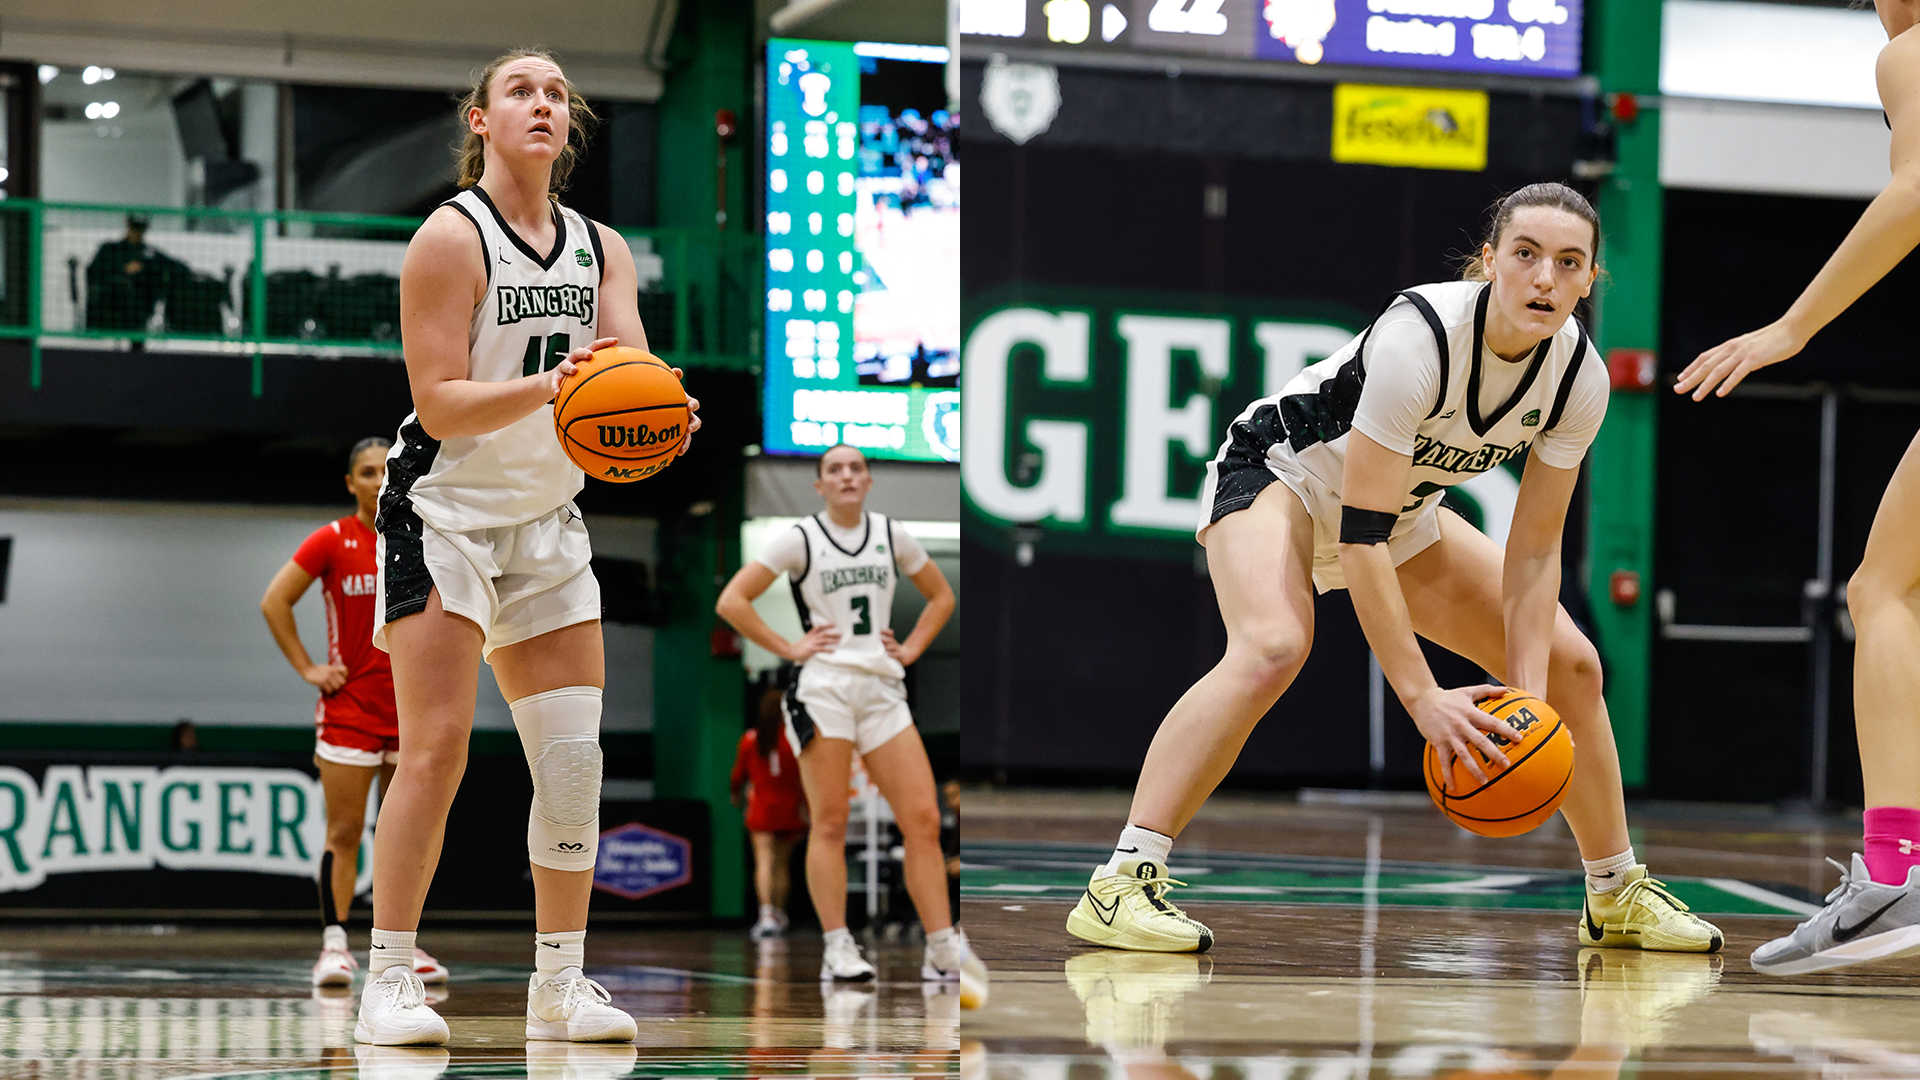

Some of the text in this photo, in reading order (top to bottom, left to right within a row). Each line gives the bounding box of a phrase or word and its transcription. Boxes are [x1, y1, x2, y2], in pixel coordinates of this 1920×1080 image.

[497, 284, 593, 326] RANGERS
[597, 423, 681, 448] Wilson
[604, 458, 669, 479] NCAA
[342, 574, 377, 597] MAR
[850, 595, 872, 636] 3
[0, 776, 368, 880] RANGER
